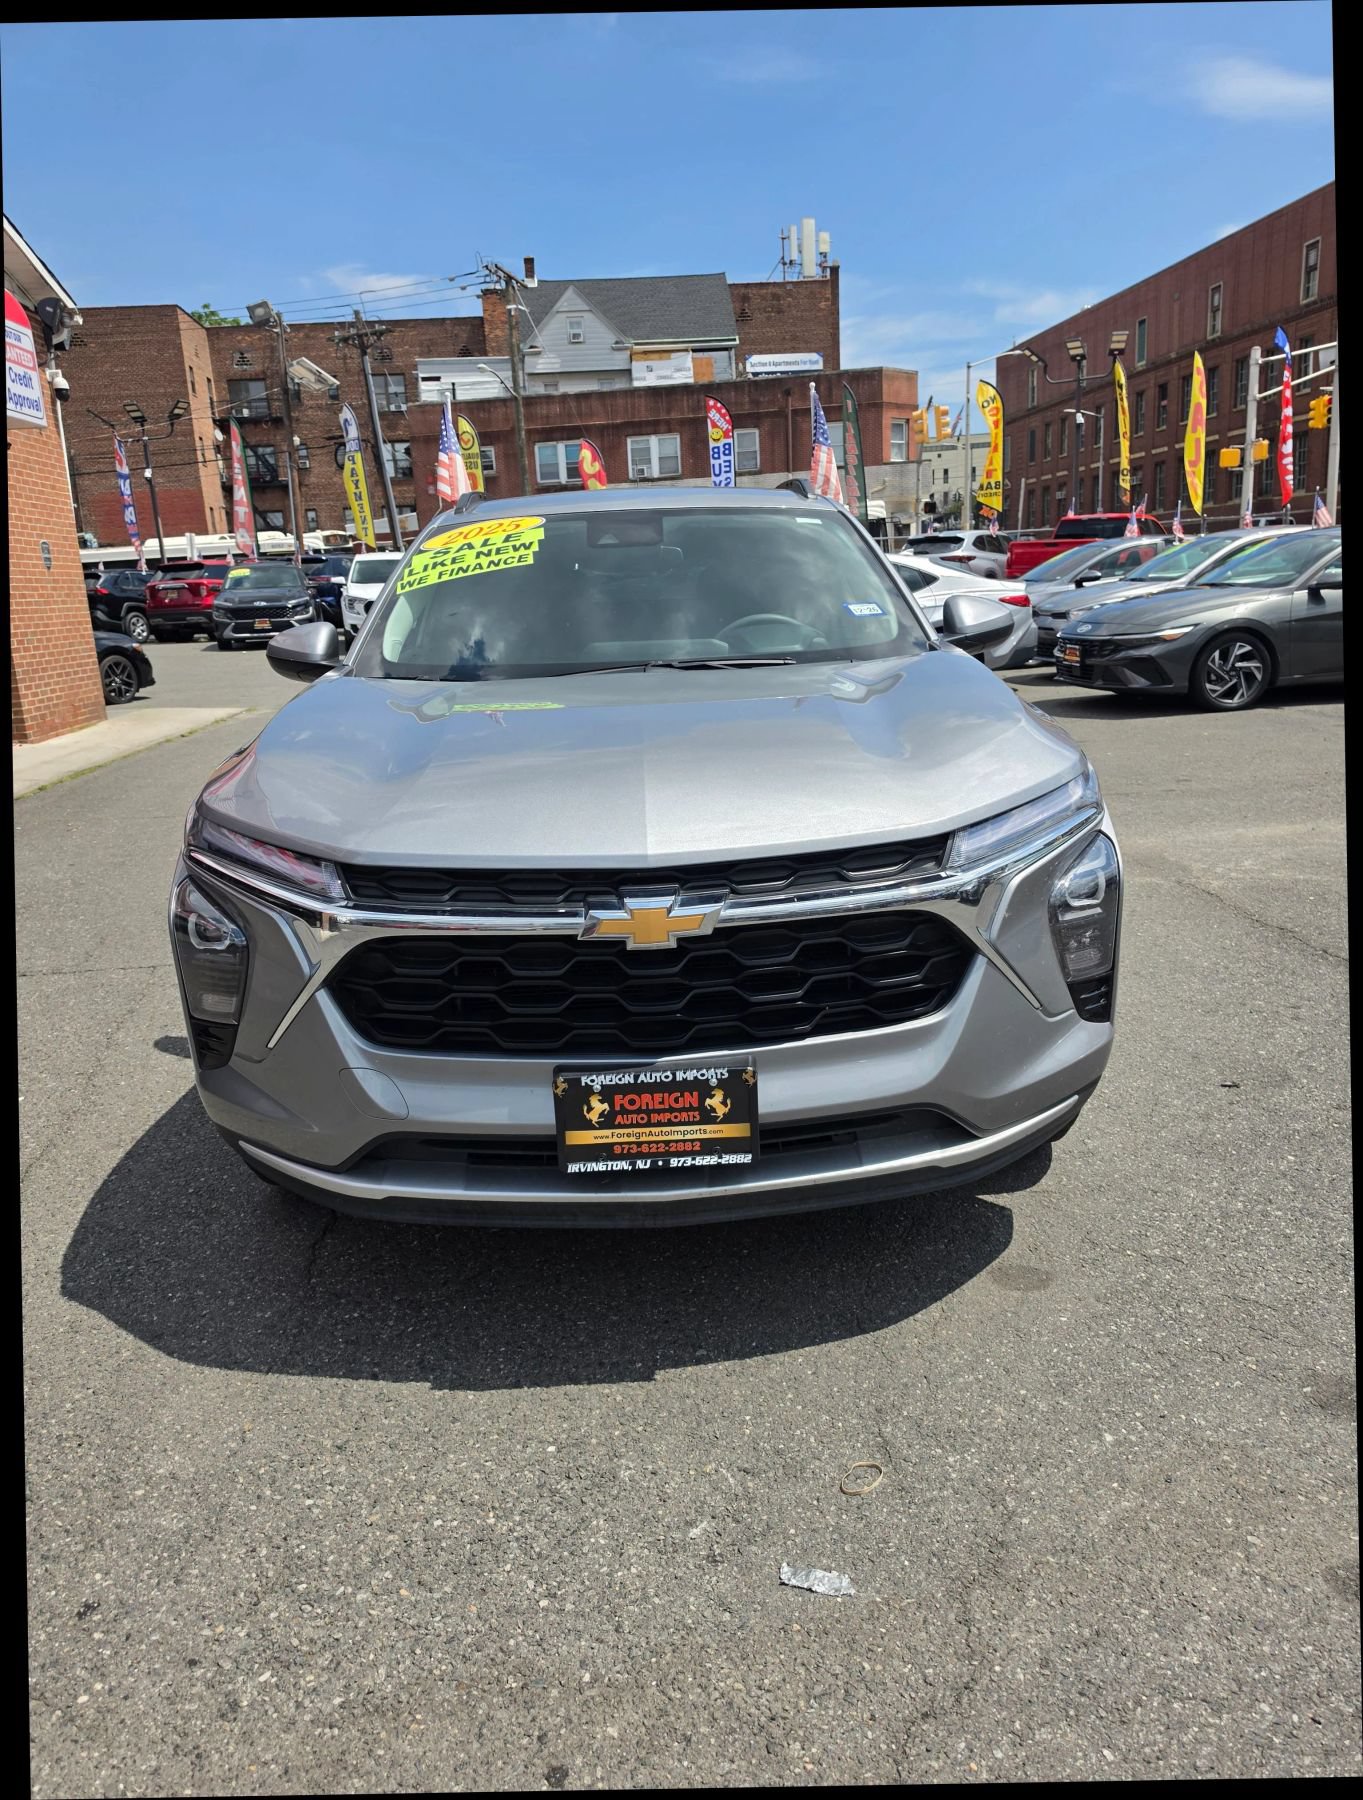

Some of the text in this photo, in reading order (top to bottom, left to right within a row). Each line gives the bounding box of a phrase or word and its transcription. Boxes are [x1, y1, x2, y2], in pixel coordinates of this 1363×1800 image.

[9, 366, 34, 390] Credit
[8, 386, 42, 413] Approval
[441, 518, 525, 546] 2025
[429, 531, 525, 559] SALE
[407, 541, 535, 578] LIKE NEW
[400, 553, 530, 590] WE FINANCE
[581, 1067, 729, 1087] FOREIGN AUTO IMPORTS
[613, 1091, 699, 1111] FOREIGN
[614, 1111, 701, 1125] AUTO IMPORTS
[593, 1126, 724, 1140] www.ForeignAutoImports.com
[612, 1141, 701, 1154] 973-622-2882
[567, 1153, 752, 1173] IRVINGTON, NJ 973-622-2882
